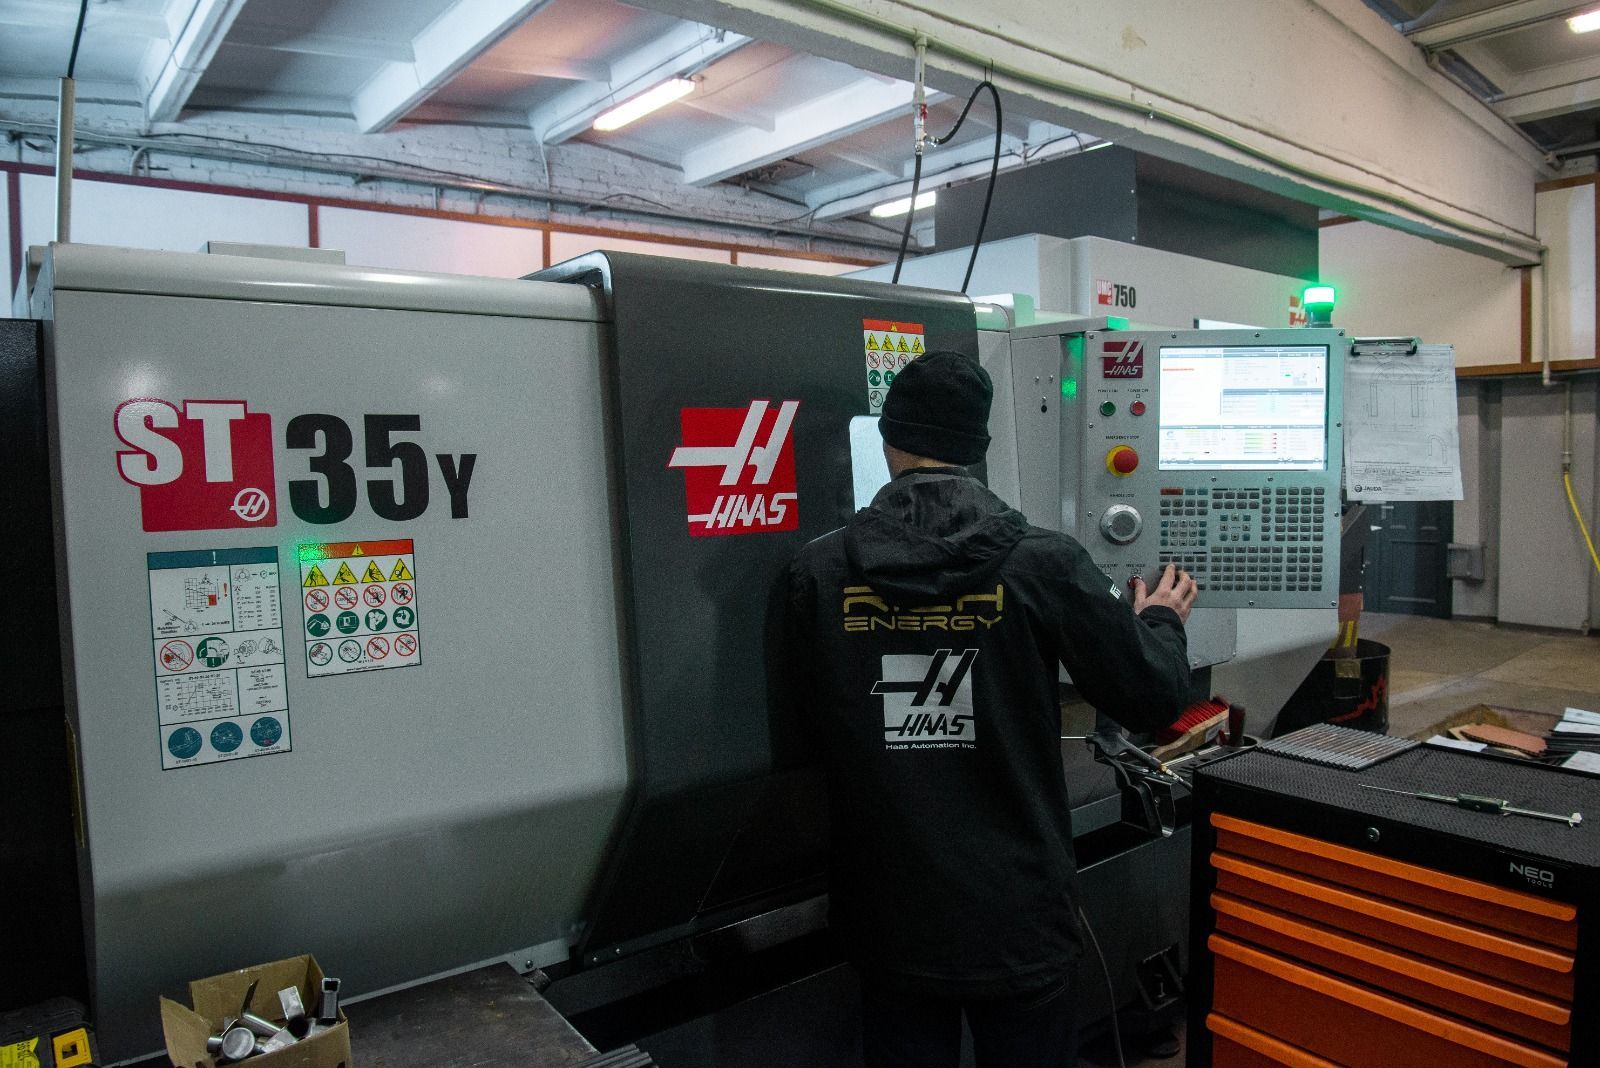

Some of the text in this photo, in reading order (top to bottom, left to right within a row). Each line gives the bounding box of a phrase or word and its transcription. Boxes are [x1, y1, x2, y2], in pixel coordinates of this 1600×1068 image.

[1114, 283, 1136, 308] 750
[1104, 365, 1143, 375] HAAS
[115, 399, 247, 486] ST
[687, 492, 798, 529] HAAS
[843, 615, 1003, 632] ENERGY
[885, 713, 975, 737] HAAS
[910, 742, 960, 750] Automation
[1509, 861, 1555, 883] NEO
[1526, 877, 1553, 889] TOOLS
